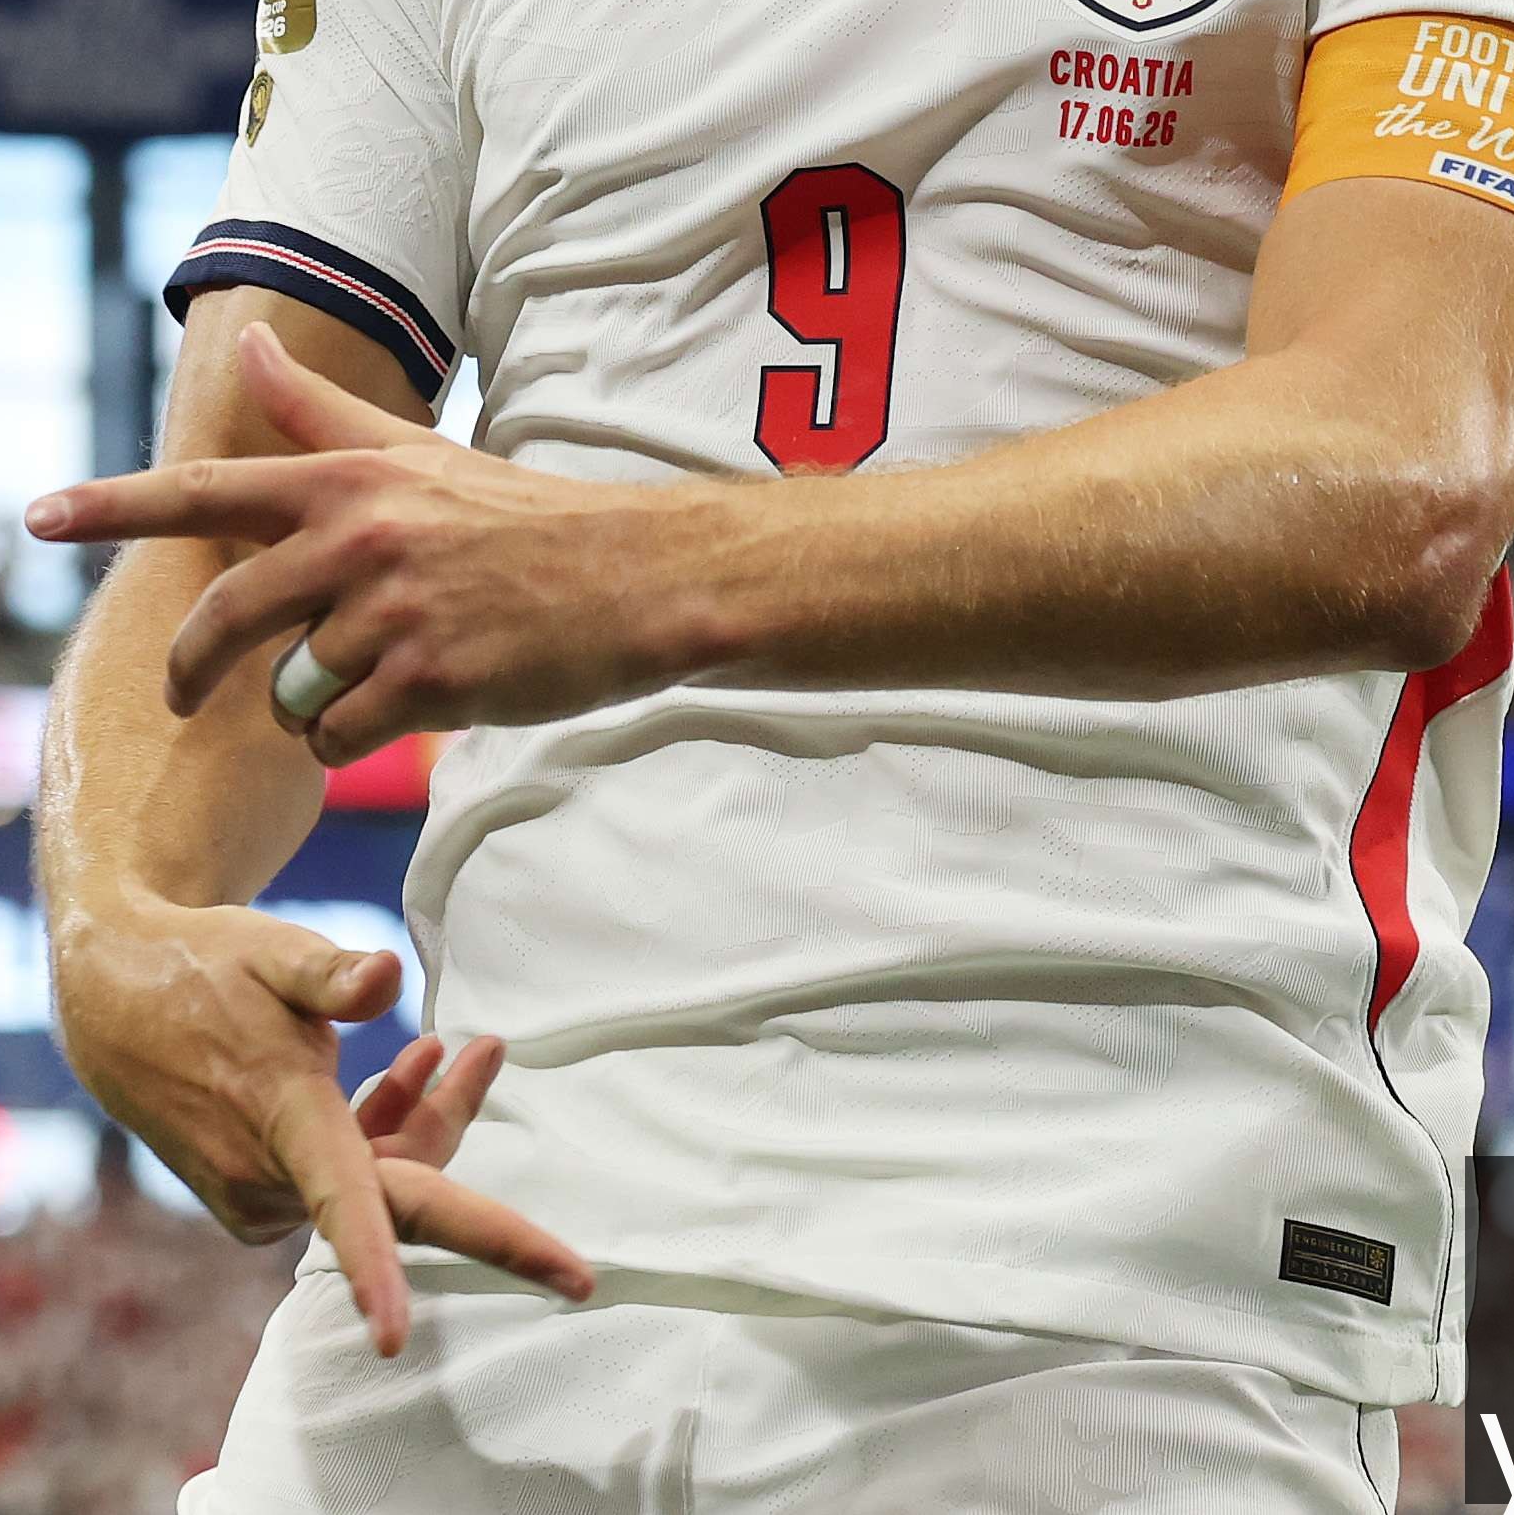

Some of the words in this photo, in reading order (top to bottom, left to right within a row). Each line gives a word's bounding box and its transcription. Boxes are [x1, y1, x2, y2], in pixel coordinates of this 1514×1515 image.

[1049, 49, 1194, 97] CROATIA
[1058, 99, 1178, 148] 17.06.26
[1373, 100, 1461, 138] the
[753, 162, 907, 479] 9
